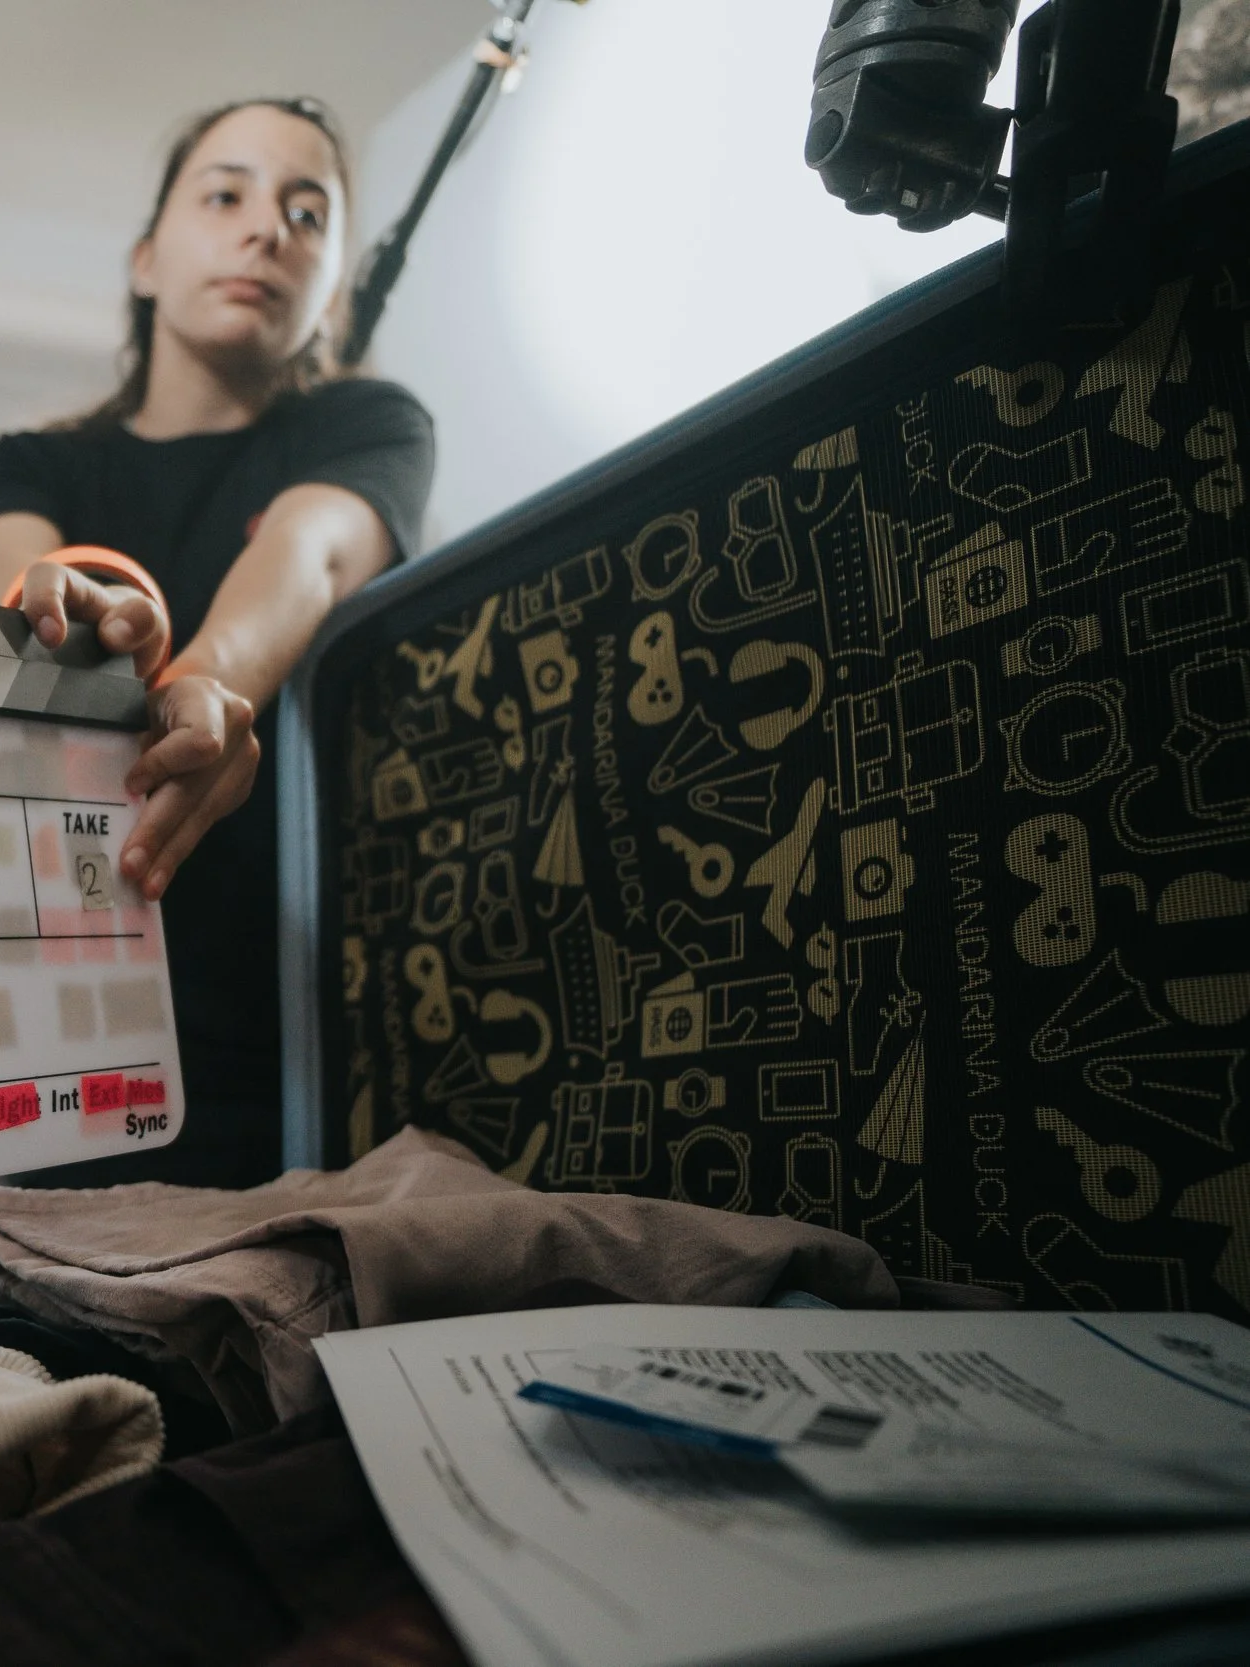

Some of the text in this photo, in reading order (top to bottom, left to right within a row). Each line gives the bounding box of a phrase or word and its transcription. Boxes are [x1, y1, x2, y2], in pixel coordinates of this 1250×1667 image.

[593, 634, 647, 930] MANDARINA DUCK
[62, 812, 110, 836] TAKE
[81, 861, 103, 897] 2
[947, 832, 1011, 1238] MANDARINA DUCK
[51, 1088, 80, 1113] Int
[125, 1111, 168, 1139] Sync
